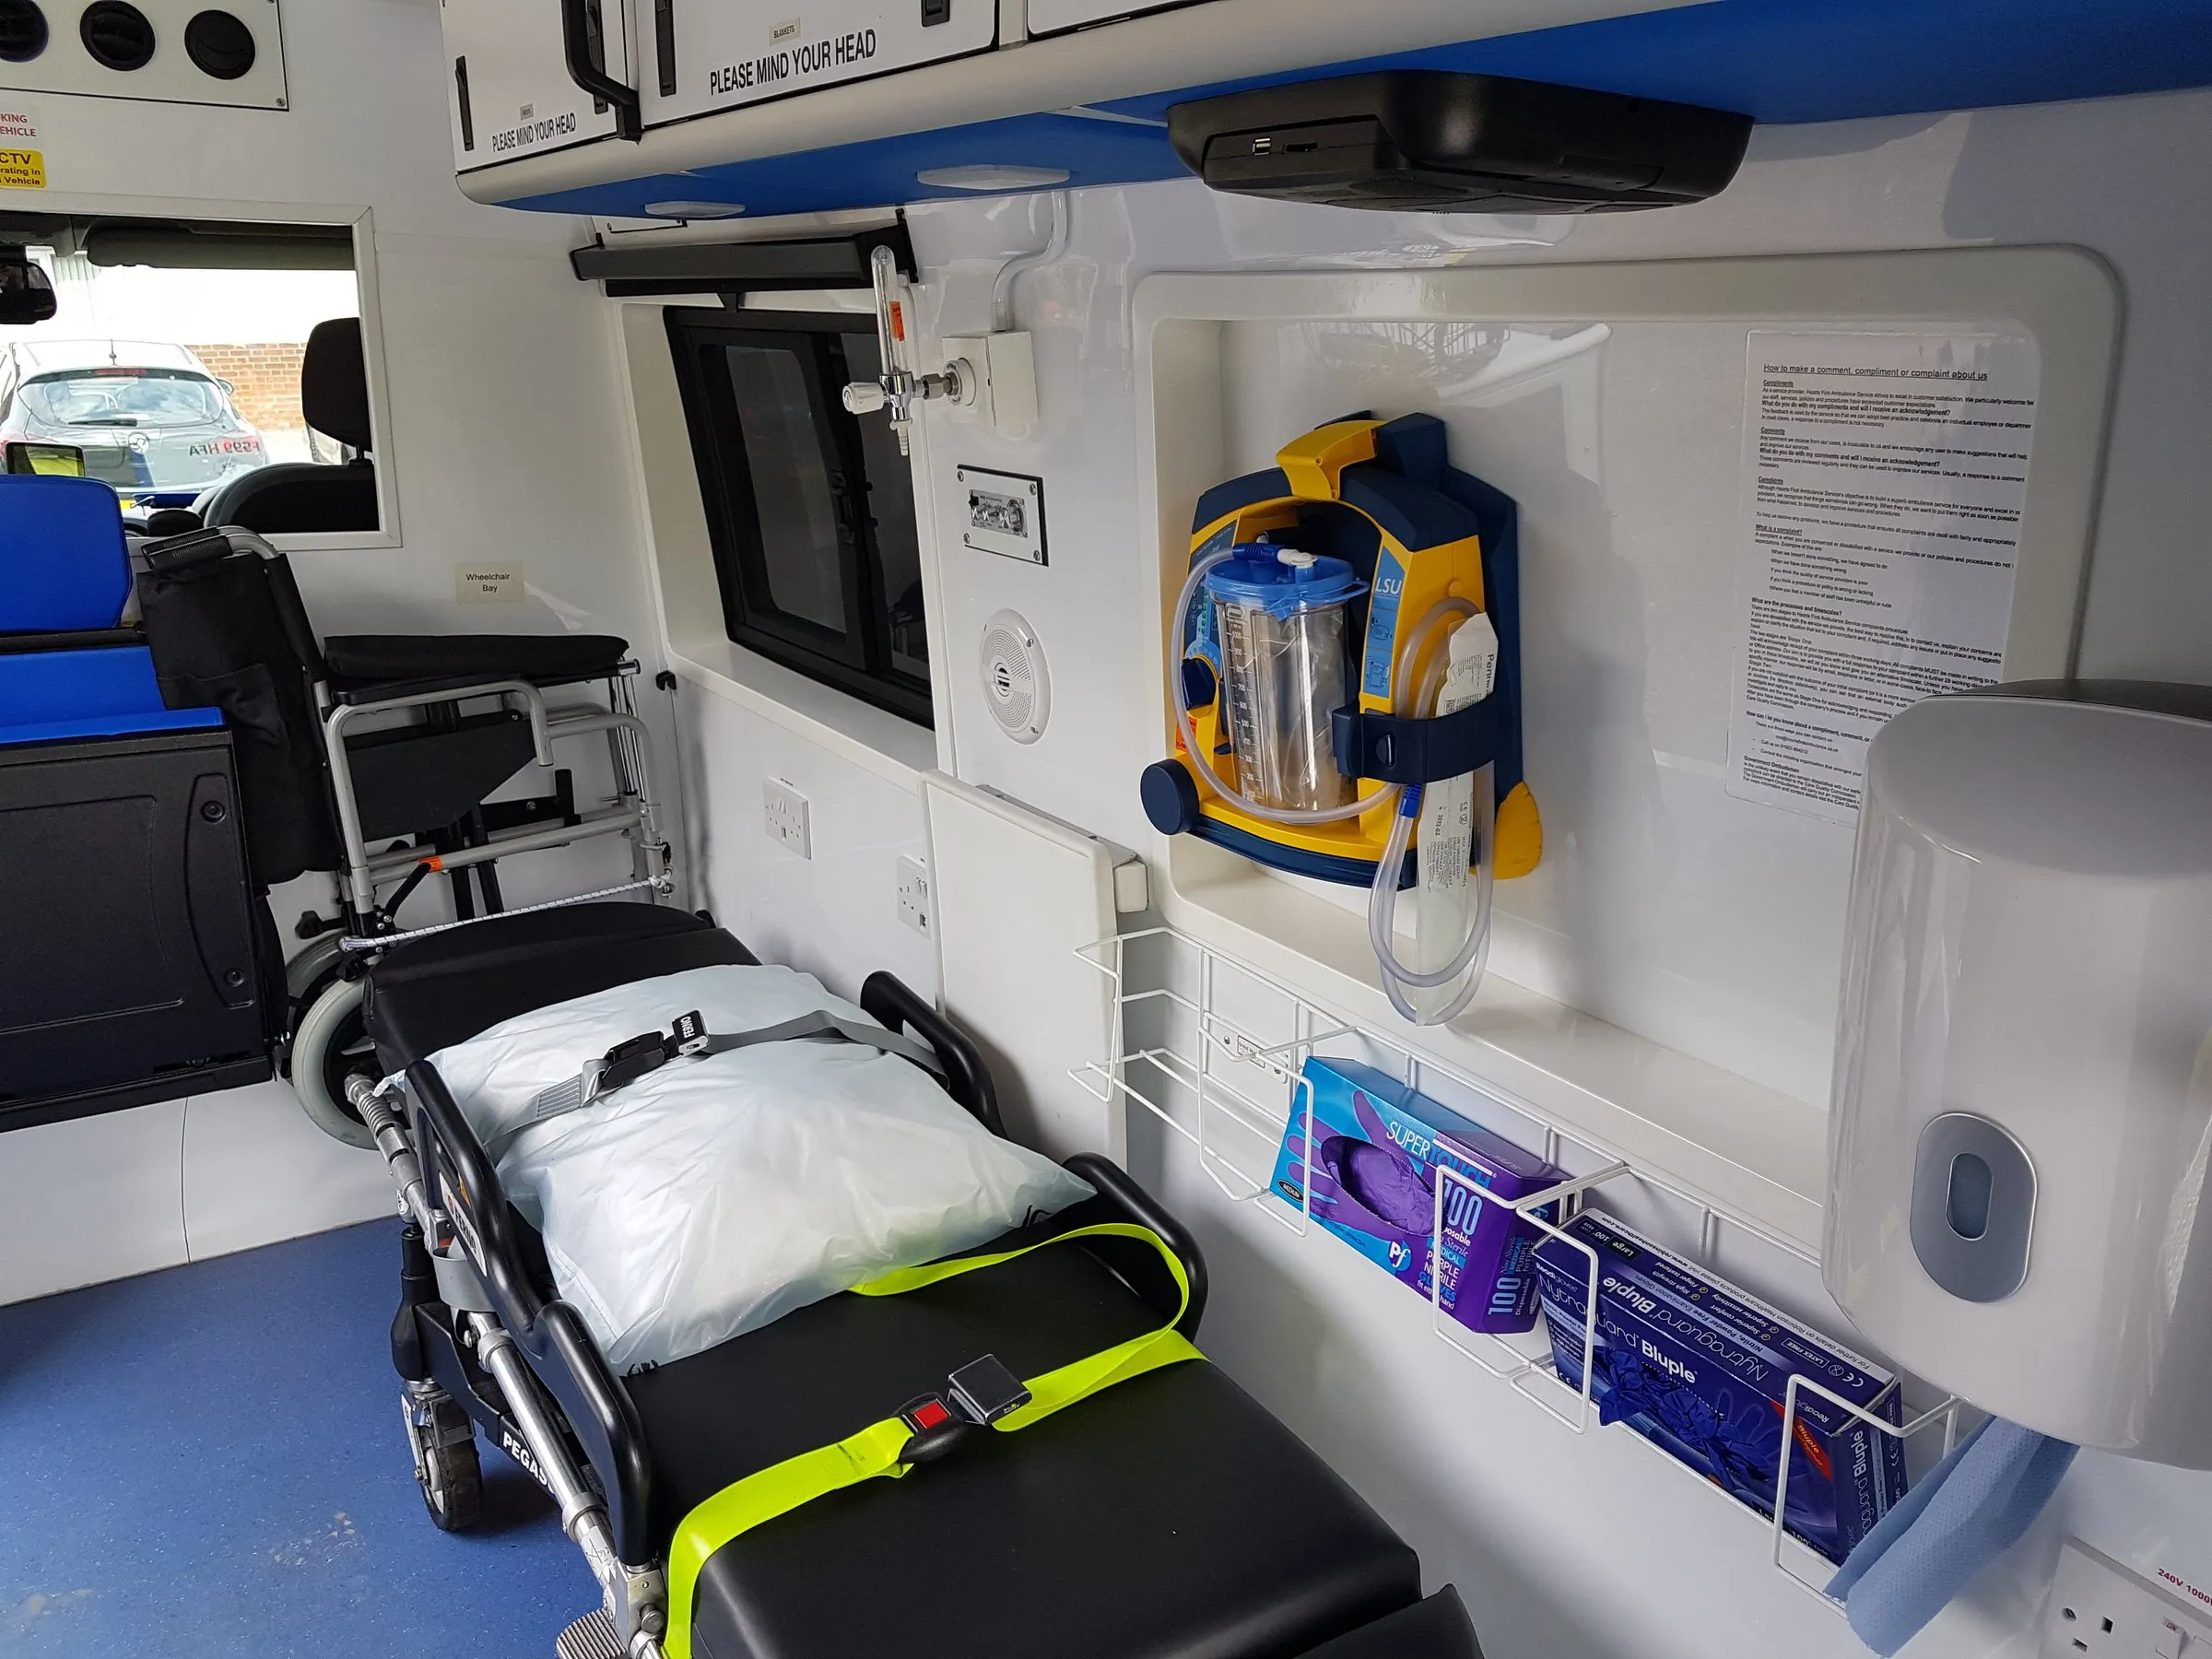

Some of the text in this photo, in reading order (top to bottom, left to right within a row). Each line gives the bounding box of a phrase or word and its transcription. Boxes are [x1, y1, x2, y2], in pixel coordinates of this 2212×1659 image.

[773, 25, 795, 39] BLANKETS
[710, 29, 877, 96] PLEASE MIND YOUR HEAD
[0, 112, 28, 124] KING
[491, 112, 576, 152] PLEASE MIND YOUR HEAD
[4, 176, 41, 185] Vehicle
[31, 168, 41, 176] in
[1854, 367, 1898, 375] compliment
[1911, 369, 1949, 378] complaint
[1951, 370, 1975, 378] about
[465, 572, 511, 581] Wheelchair
[1374, 577, 1403, 594] LSU
[482, 584, 498, 594] Bay
[680, 1016, 696, 1039] FERNO
[1283, 1182, 1300, 1198] MEDIUM
[1443, 1179, 1483, 1236] 100
[1594, 1230, 1610, 1242] 100
[1601, 1215, 1688, 1267] www.robinsonhealthcare.com
[1445, 1237, 1469, 1257] Sterile
[1515, 1240, 1530, 1273] PURPLE
[1611, 1240, 1634, 1257] Large
[1651, 1268, 1690, 1295] High strength
[1654, 1259, 1699, 1288] Finger textured
[1488, 1277, 1522, 1316] 100
[1514, 1277, 1531, 1316] Disposable
[1719, 1281, 1745, 1300] products
[1439, 1295, 1455, 1310] hand
[1712, 1291, 1769, 1328] Superior sensitivity
[1744, 1295, 1776, 1317] Healthcare
[1633, 1274, 1764, 1353] Nitrile, Powder Free Examination Gloves
[1710, 1301, 1760, 1335] Superior comfort
[1776, 1313, 1805, 1334] Robinson
[1603, 1276, 1770, 1382] Nytraguard Bluple
[1805, 1329, 1815, 1337] on
[1785, 1339, 1823, 1365] LATEX FREE
[1814, 1335, 1836, 1350] details
[1641, 1340, 1696, 1383] Bluple
[1834, 1346, 1858, 1363] further
[1856, 1359, 1870, 1370] For
[1797, 1424, 1820, 1454] Bluple
[1851, 1429, 1868, 1477] Bluple
[2158, 1568, 2183, 1587] 240V
